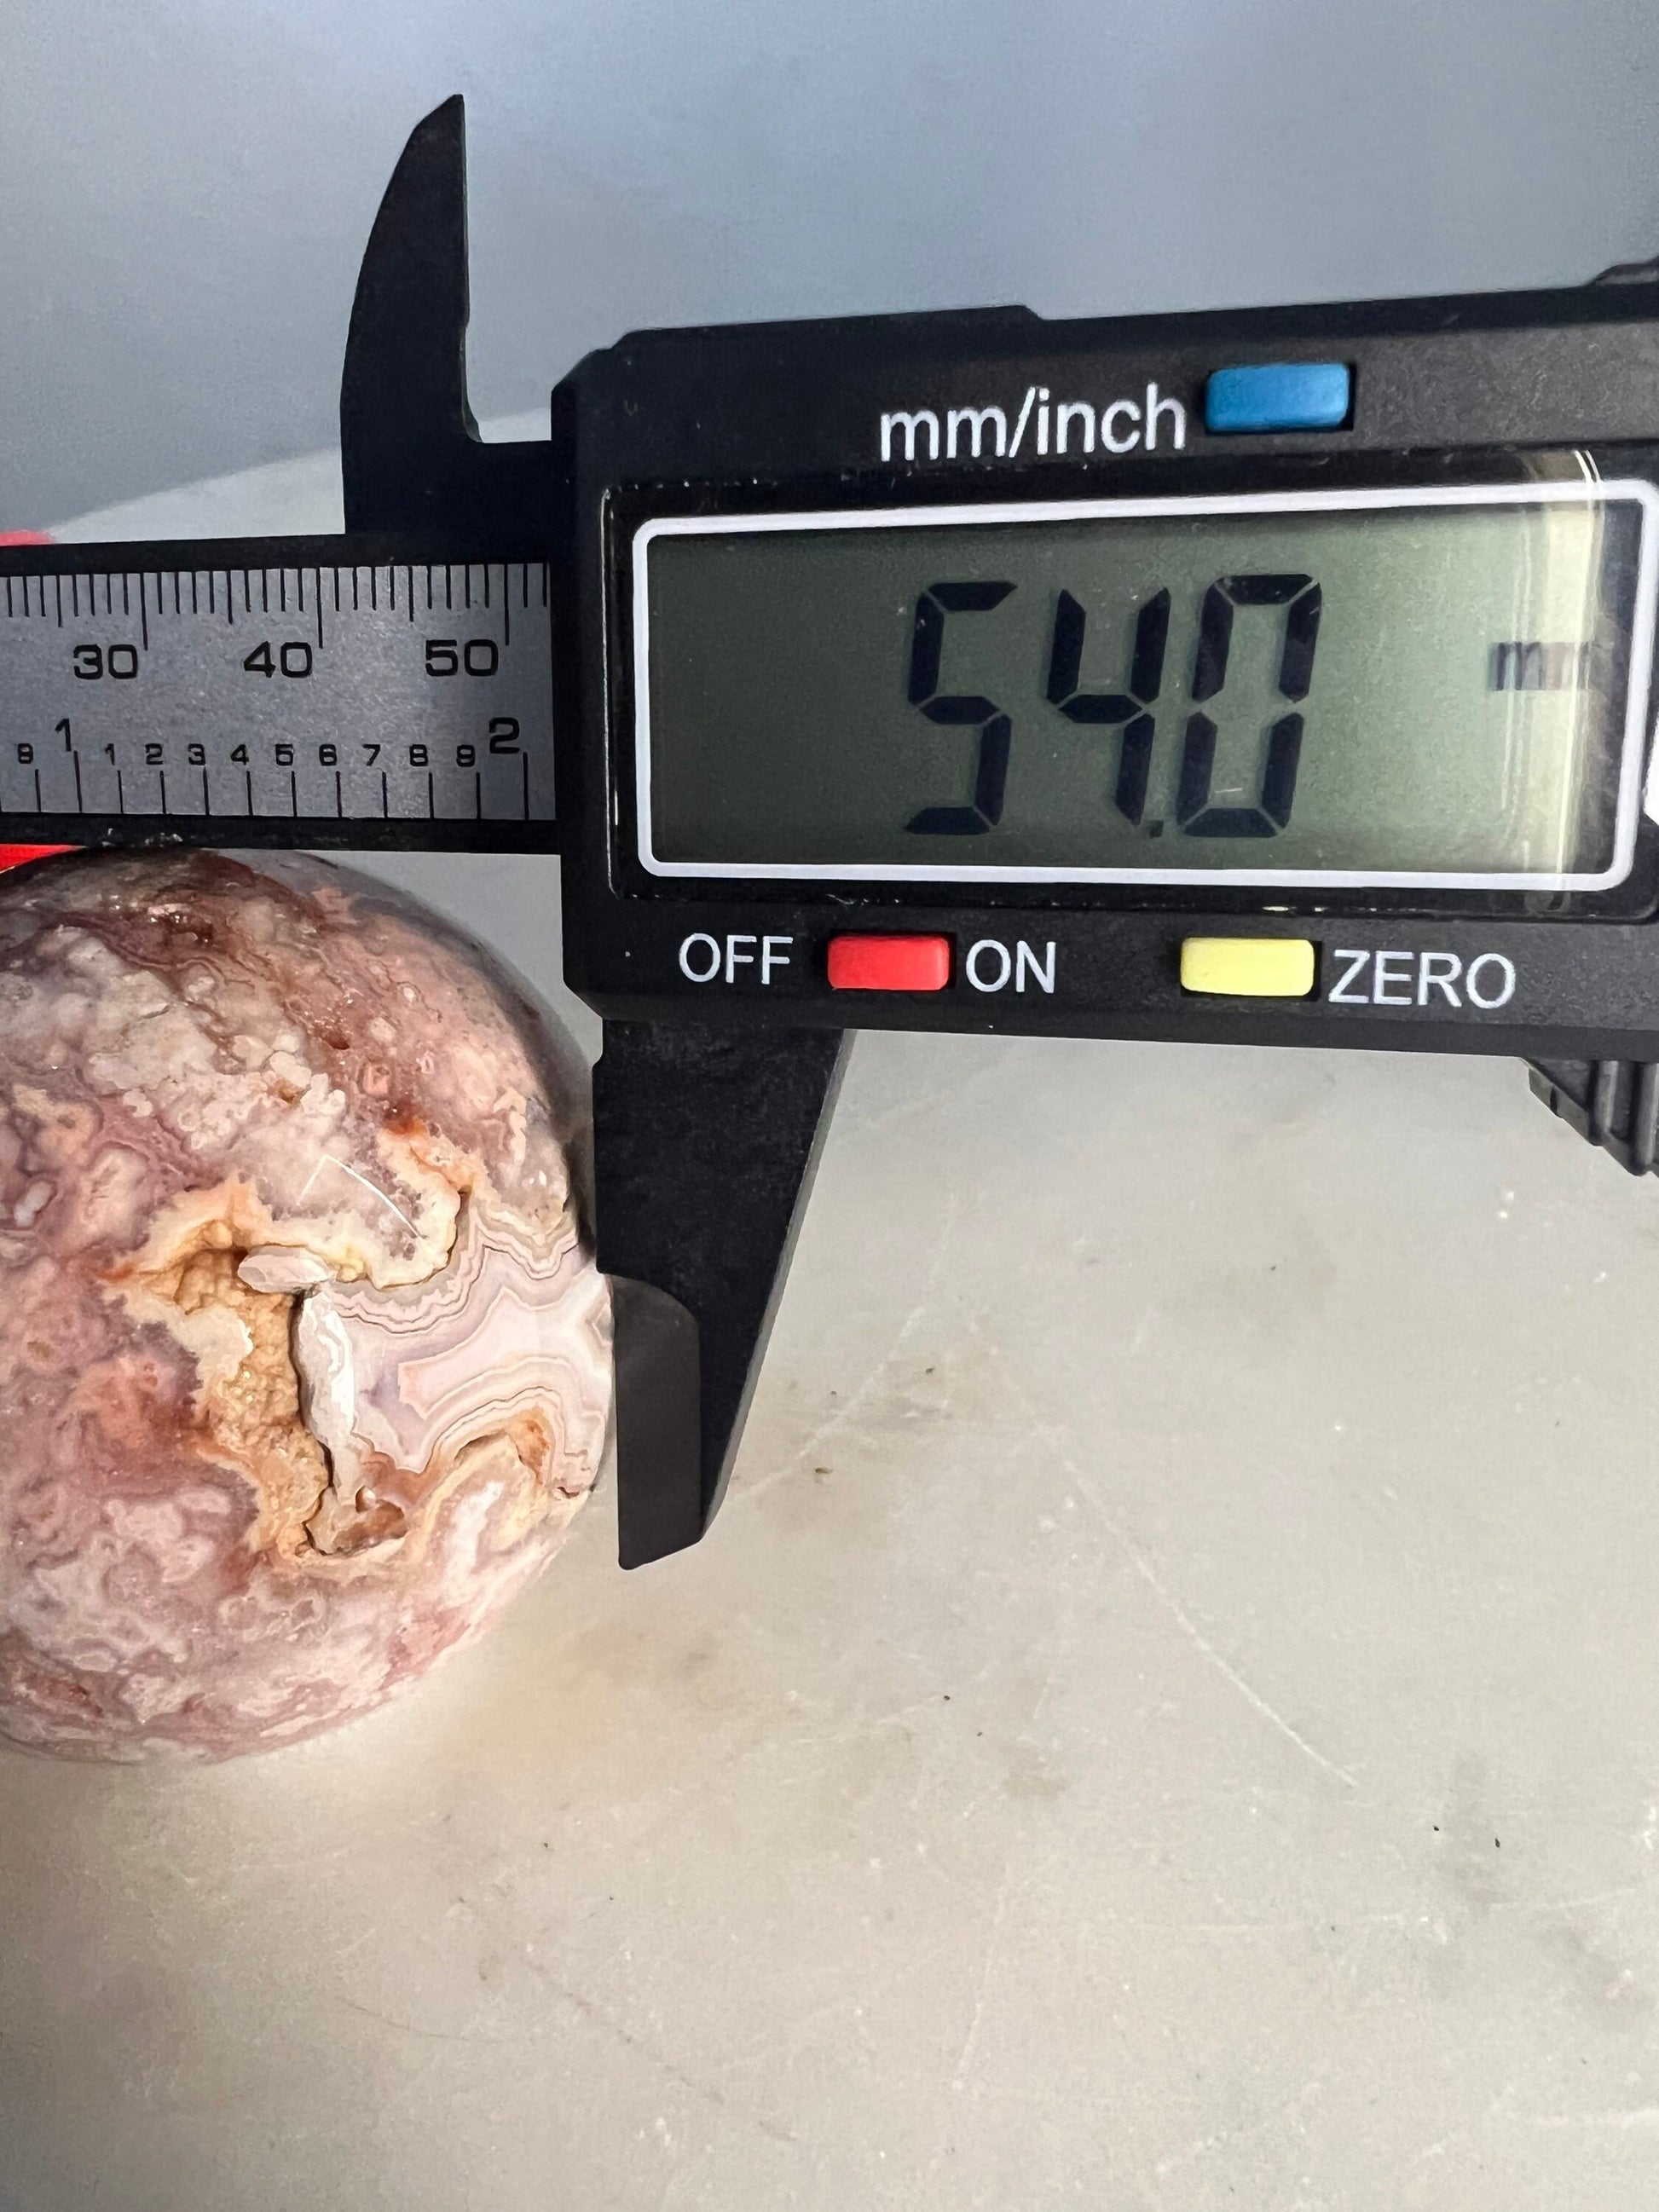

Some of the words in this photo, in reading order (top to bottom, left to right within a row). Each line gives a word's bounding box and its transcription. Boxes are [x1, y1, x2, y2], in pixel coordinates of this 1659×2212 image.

[878, 384, 1186, 463] mm/inch
[72, 644, 139, 680] 30
[243, 640, 313, 679] 40
[425, 638, 499, 677] 50
[904, 574, 1323, 839] 54.0
[55, 718, 72, 752] 1
[104, 742, 116, 766] 1
[144, 742, 164, 766] 2
[188, 743, 206, 766] 3
[230, 743, 250, 766] 4
[275, 743, 294, 767] 5
[319, 743, 338, 767] 6
[361, 743, 381, 767] 7
[408, 743, 429, 768] 8
[488, 716, 521, 755] 2
[679, 933, 794, 985] OFF
[965, 939, 1056, 995] ON
[1327, 948, 1517, 1010] ZERO
